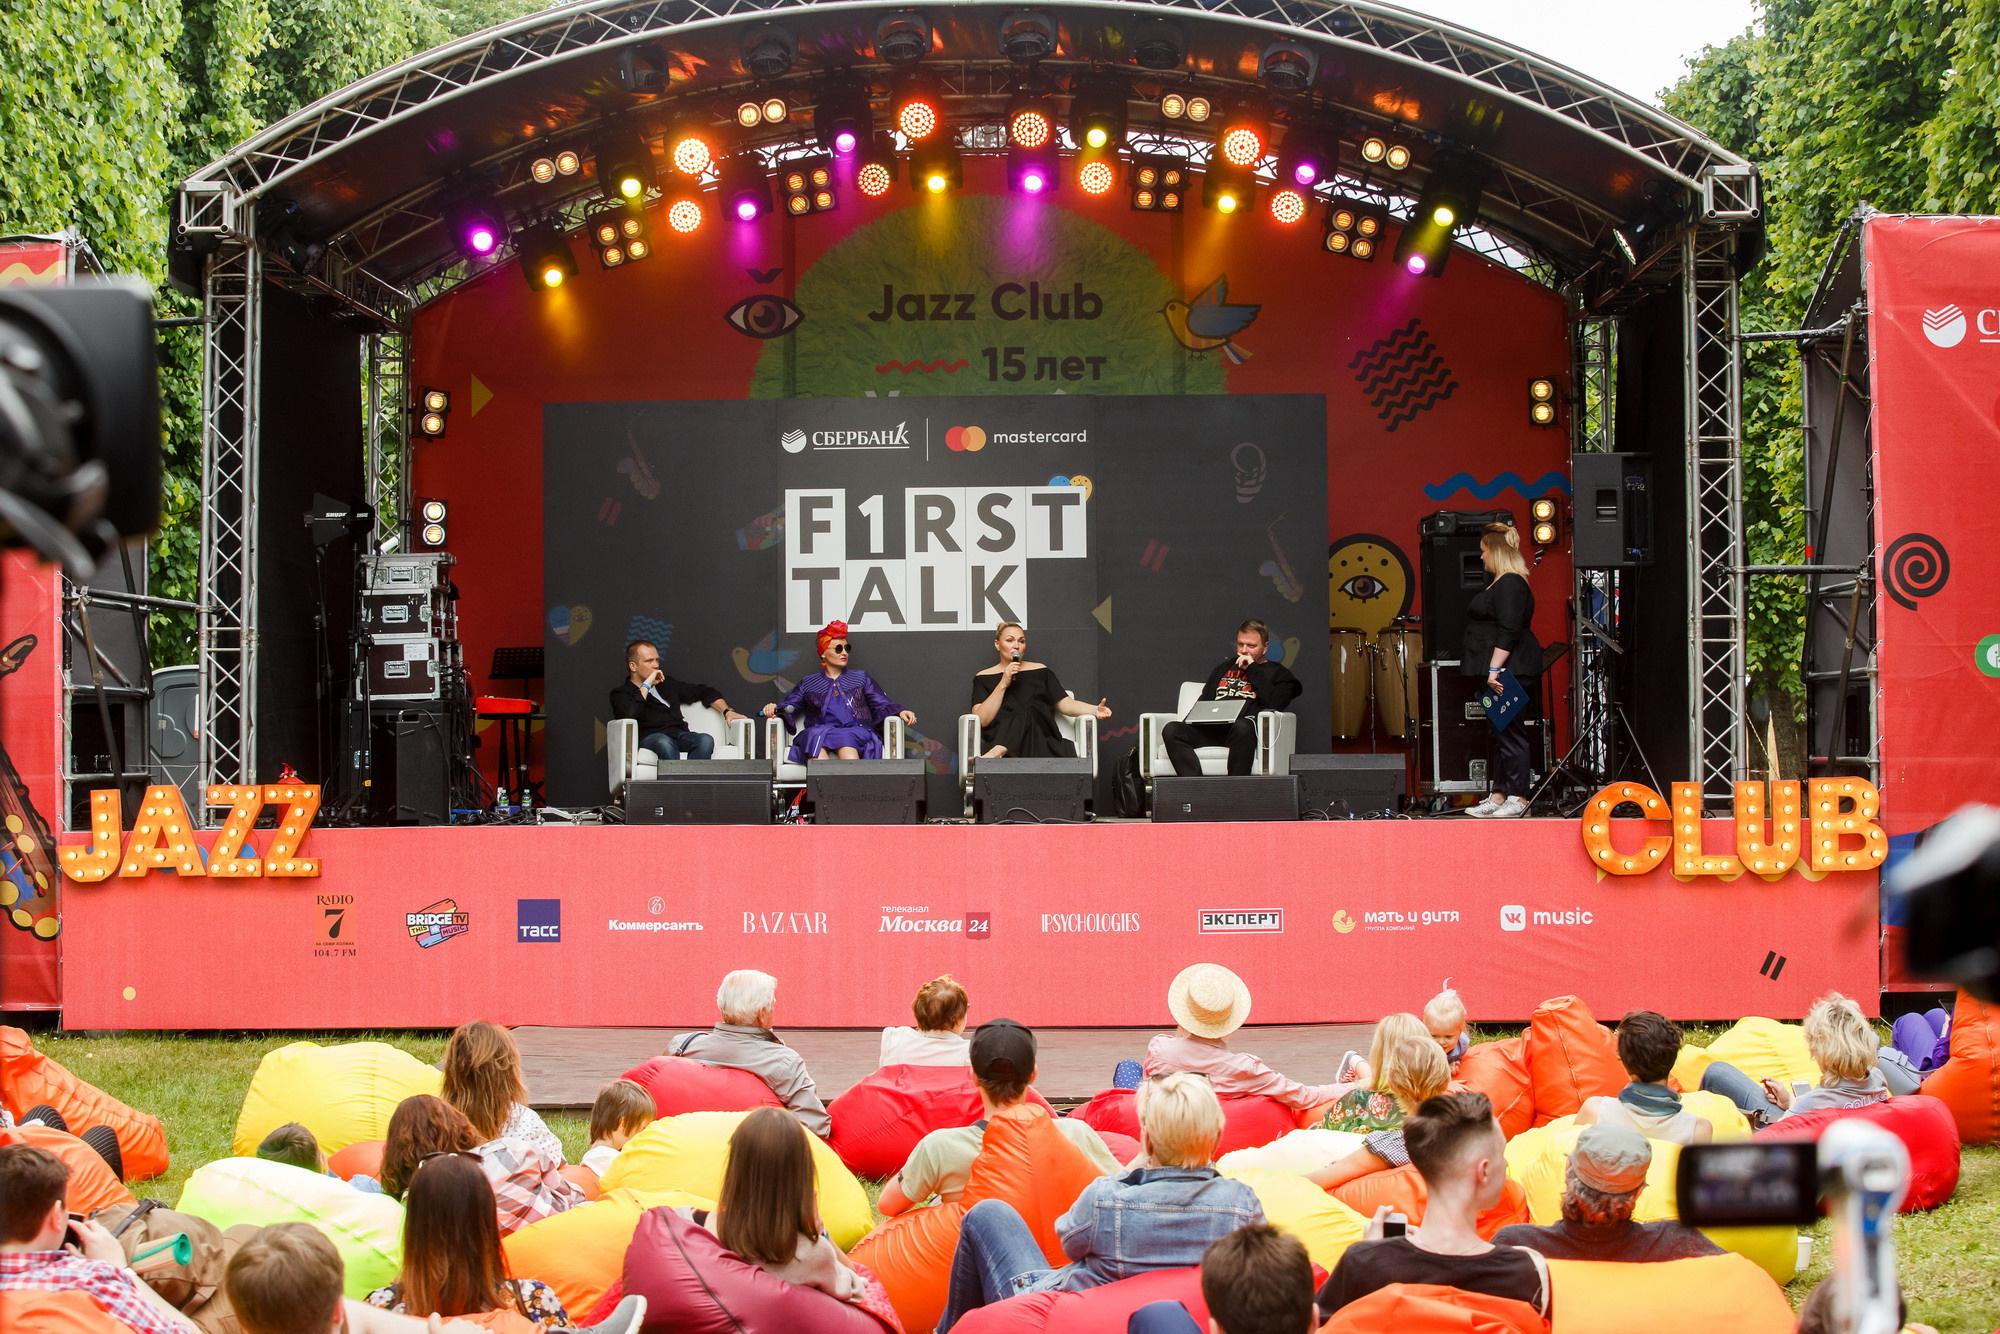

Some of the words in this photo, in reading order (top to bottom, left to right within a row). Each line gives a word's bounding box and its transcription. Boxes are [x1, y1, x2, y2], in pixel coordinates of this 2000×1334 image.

[867, 284, 976, 322] Jazz
[991, 281, 1103, 321] Club
[1976, 308, 2000, 335] С
[981, 347, 1027, 382] 15
[1034, 356, 1107, 381] лет
[812, 421, 910, 446] СБЕРБАНК
[993, 430, 1087, 444] mastercard
[799, 492, 1081, 554] F1RST
[792, 565, 1021, 625] TALK
[58, 784, 322, 883] JAZZ
[1581, 776, 1889, 876] CLUB
[316, 894, 354, 906] RADIO
[881, 905, 929, 913] телеканал
[325, 908, 346, 939] 7
[454, 915, 466, 923] TV
[742, 911, 829, 935] BAZAAR
[878, 916, 963, 932] Москва
[968, 920, 989, 932] 24
[1203, 913, 1279, 926] ЭКСПЕРТ
[1364, 911, 1405, 923] мать
[1421, 911, 1460, 925] дитя
[1533, 906, 1594, 925] music
[411, 926, 428, 934] THIS
[442, 926, 465, 935] MUSIC
[608, 919, 704, 932] Коммерсантъ
[314, 949, 339, 957] 104.7
[342, 949, 356, 957] FM
